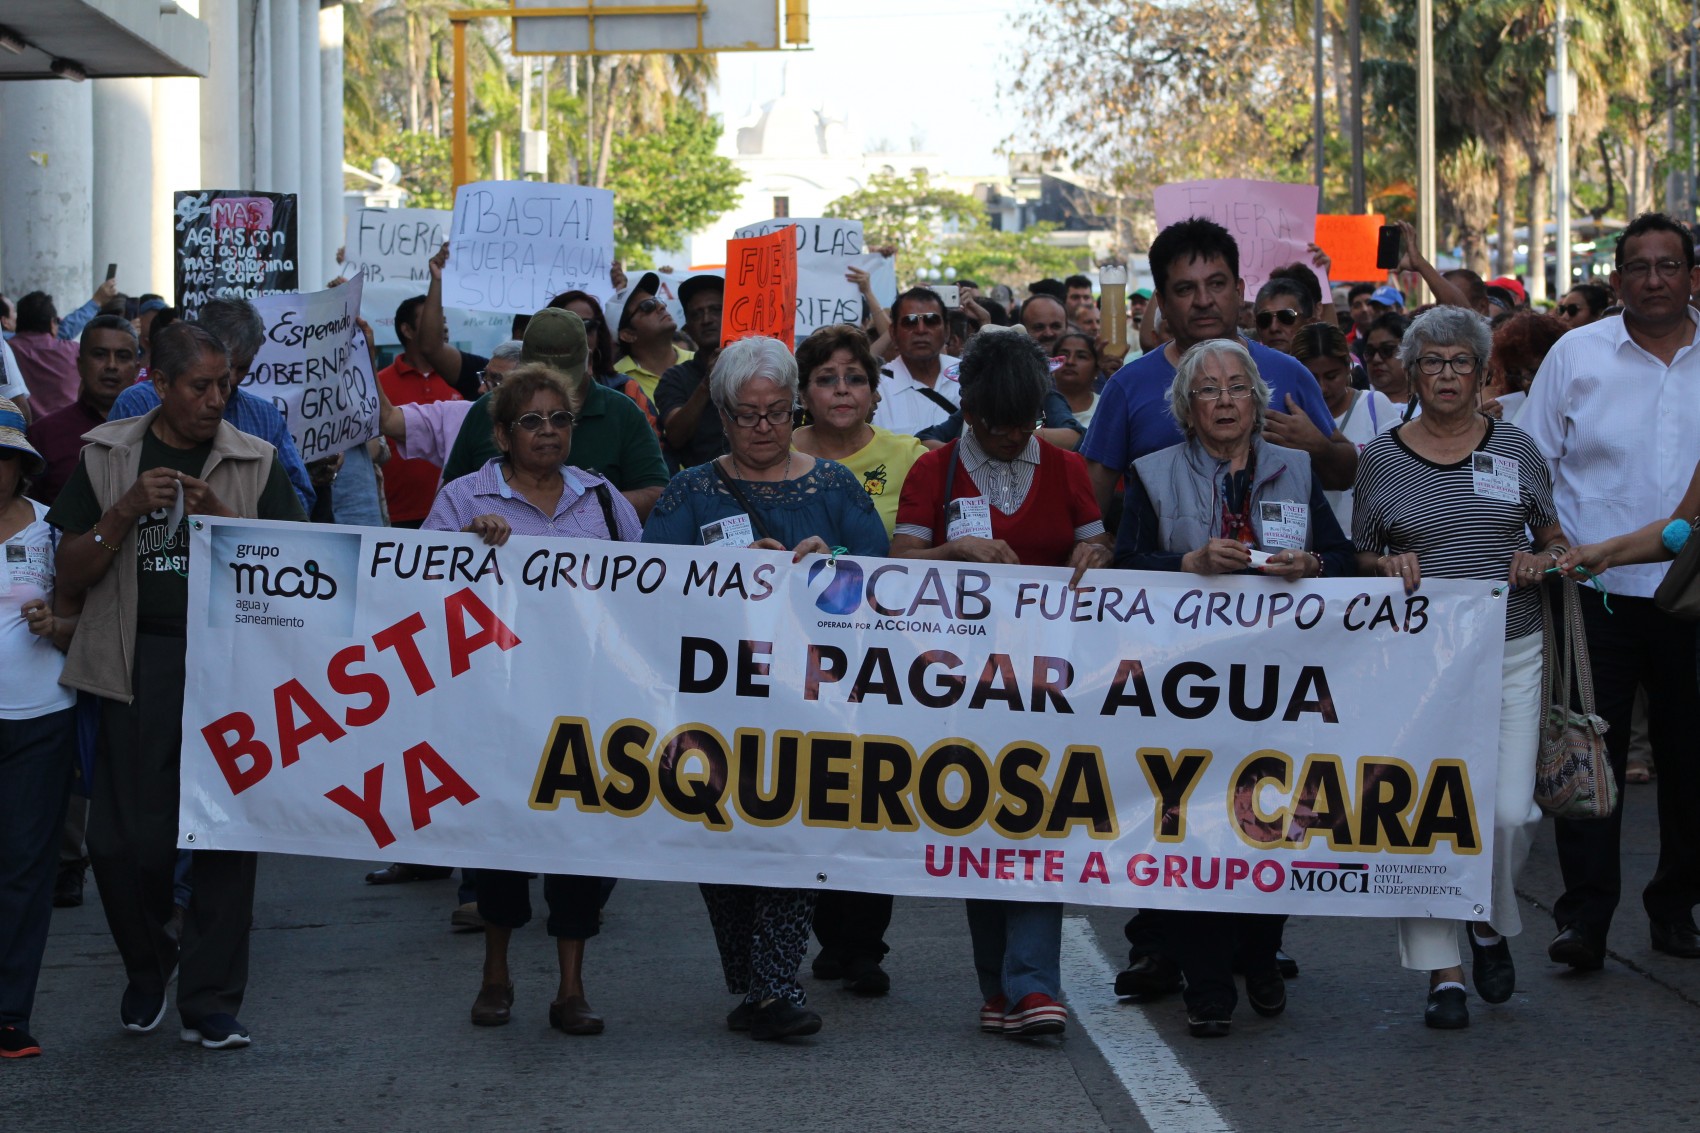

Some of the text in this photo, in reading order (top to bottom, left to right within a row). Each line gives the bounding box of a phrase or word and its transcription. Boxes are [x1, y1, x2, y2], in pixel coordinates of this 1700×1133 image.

[212, 202, 264, 224] MAS
[184, 227, 246, 247] AGUAS
[357, 208, 444, 257] FUERA
[814, 224, 861, 256] LAS
[454, 239, 605, 280] FUERA AGUA
[739, 243, 787, 288] FUE
[1239, 238, 1293, 268] UPO
[183, 271, 215, 284] MAS
[268, 301, 351, 349] Esperando
[301, 365, 367, 420] GRUPO
[155, 555, 188, 571] EAST
[236, 544, 280, 558] grupo
[371, 541, 776, 601] FUERA GRUPO MAS
[235, 600, 262, 612] agua
[865, 564, 992, 620] CAB
[1014, 583, 1430, 634] FUERA GRUPO CAB
[235, 613, 304, 628] saneamiento
[817, 619, 987, 636] OPERADA POR ACCIONA AGUA
[200, 587, 523, 796] BASTA
[678, 636, 1340, 724] DE PAGAR AGUA
[323, 740, 481, 849] YA
[528, 715, 1482, 855] ASQUEROSA Y CARA
[925, 844, 1286, 893] UNETE A GRUPO
[1374, 875, 1403, 885] CIVIL
[1375, 864, 1447, 875] MOVIMIENTO
[1373, 885, 1462, 896] INDEPENDIENTE
